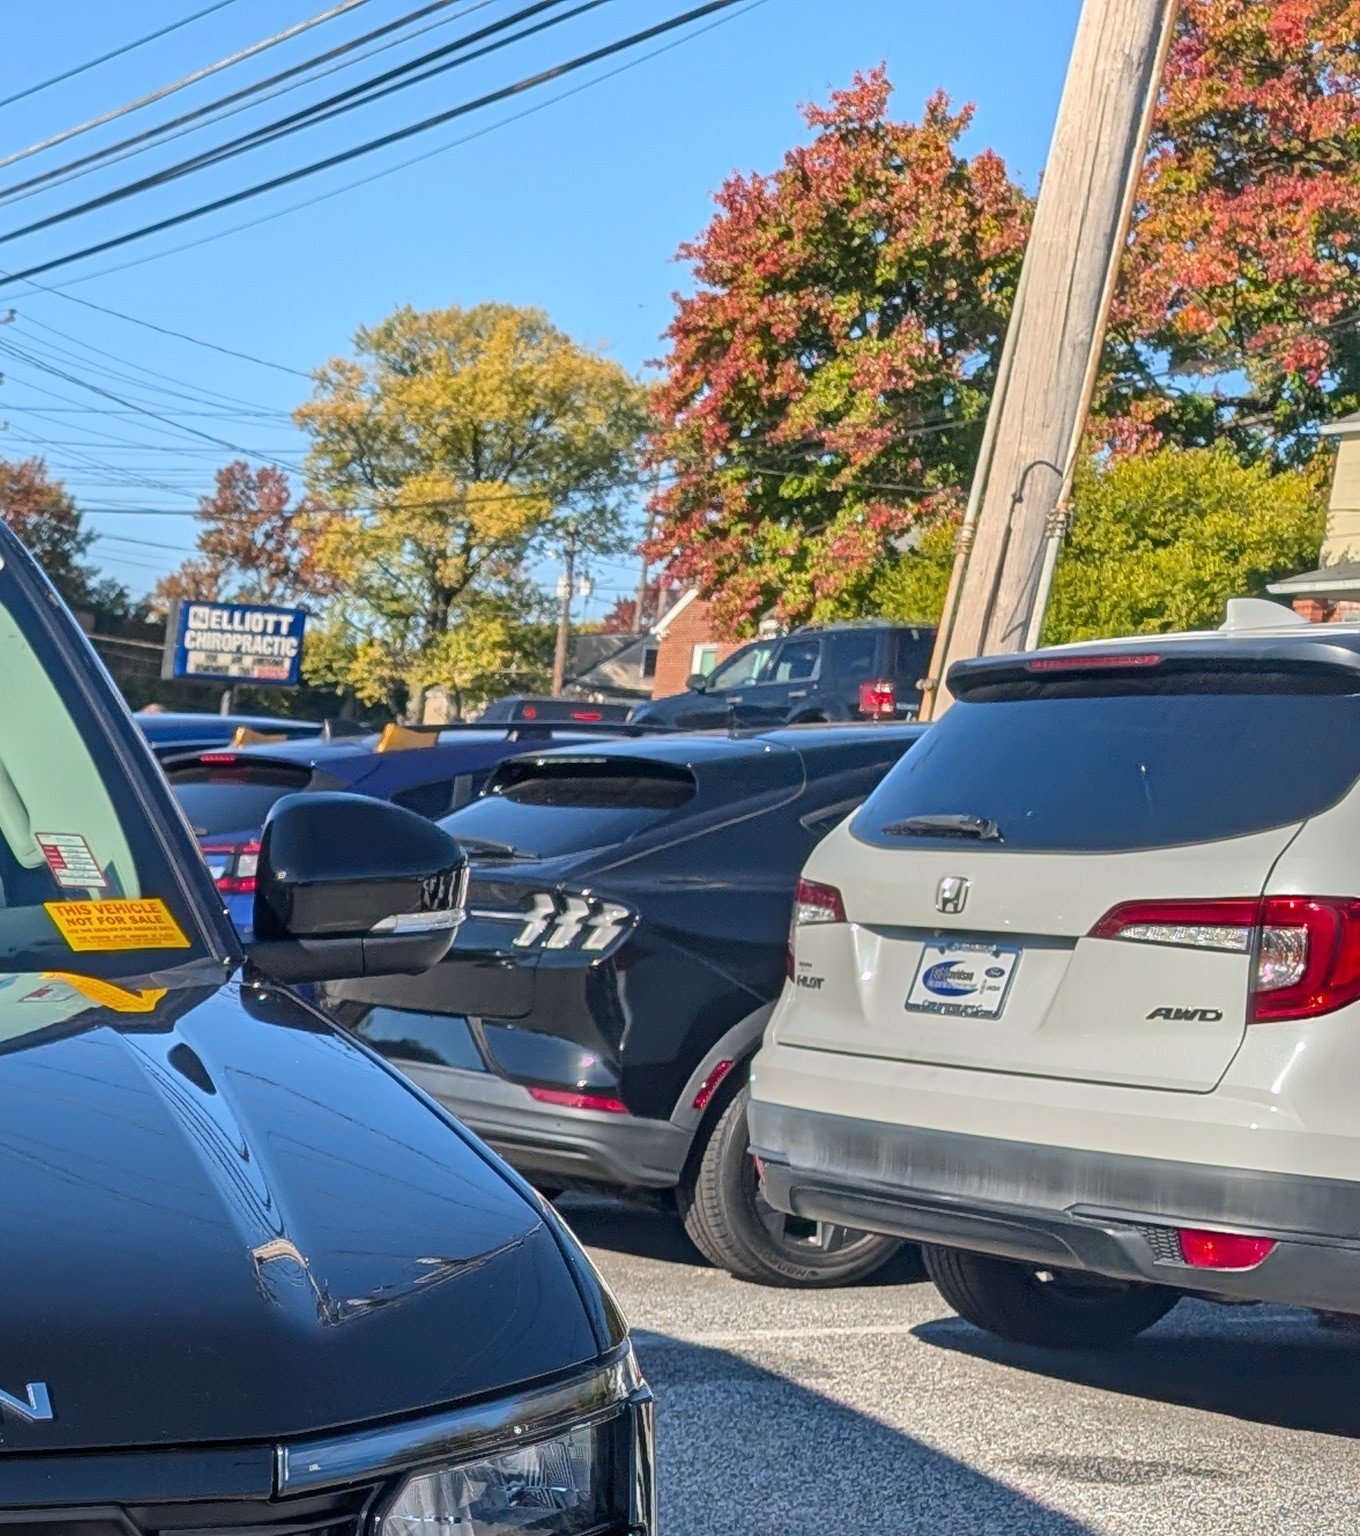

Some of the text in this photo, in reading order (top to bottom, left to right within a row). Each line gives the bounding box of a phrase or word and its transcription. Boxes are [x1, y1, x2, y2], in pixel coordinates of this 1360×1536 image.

[211, 608, 294, 635] ELLIOTT
[184, 629, 299, 657] CHIROPRACTIC
[54, 902, 161, 917] THIS VEHICLE
[65, 914, 165, 927] NOT FOR SALE
[1145, 1007, 1223, 1022] AWD
